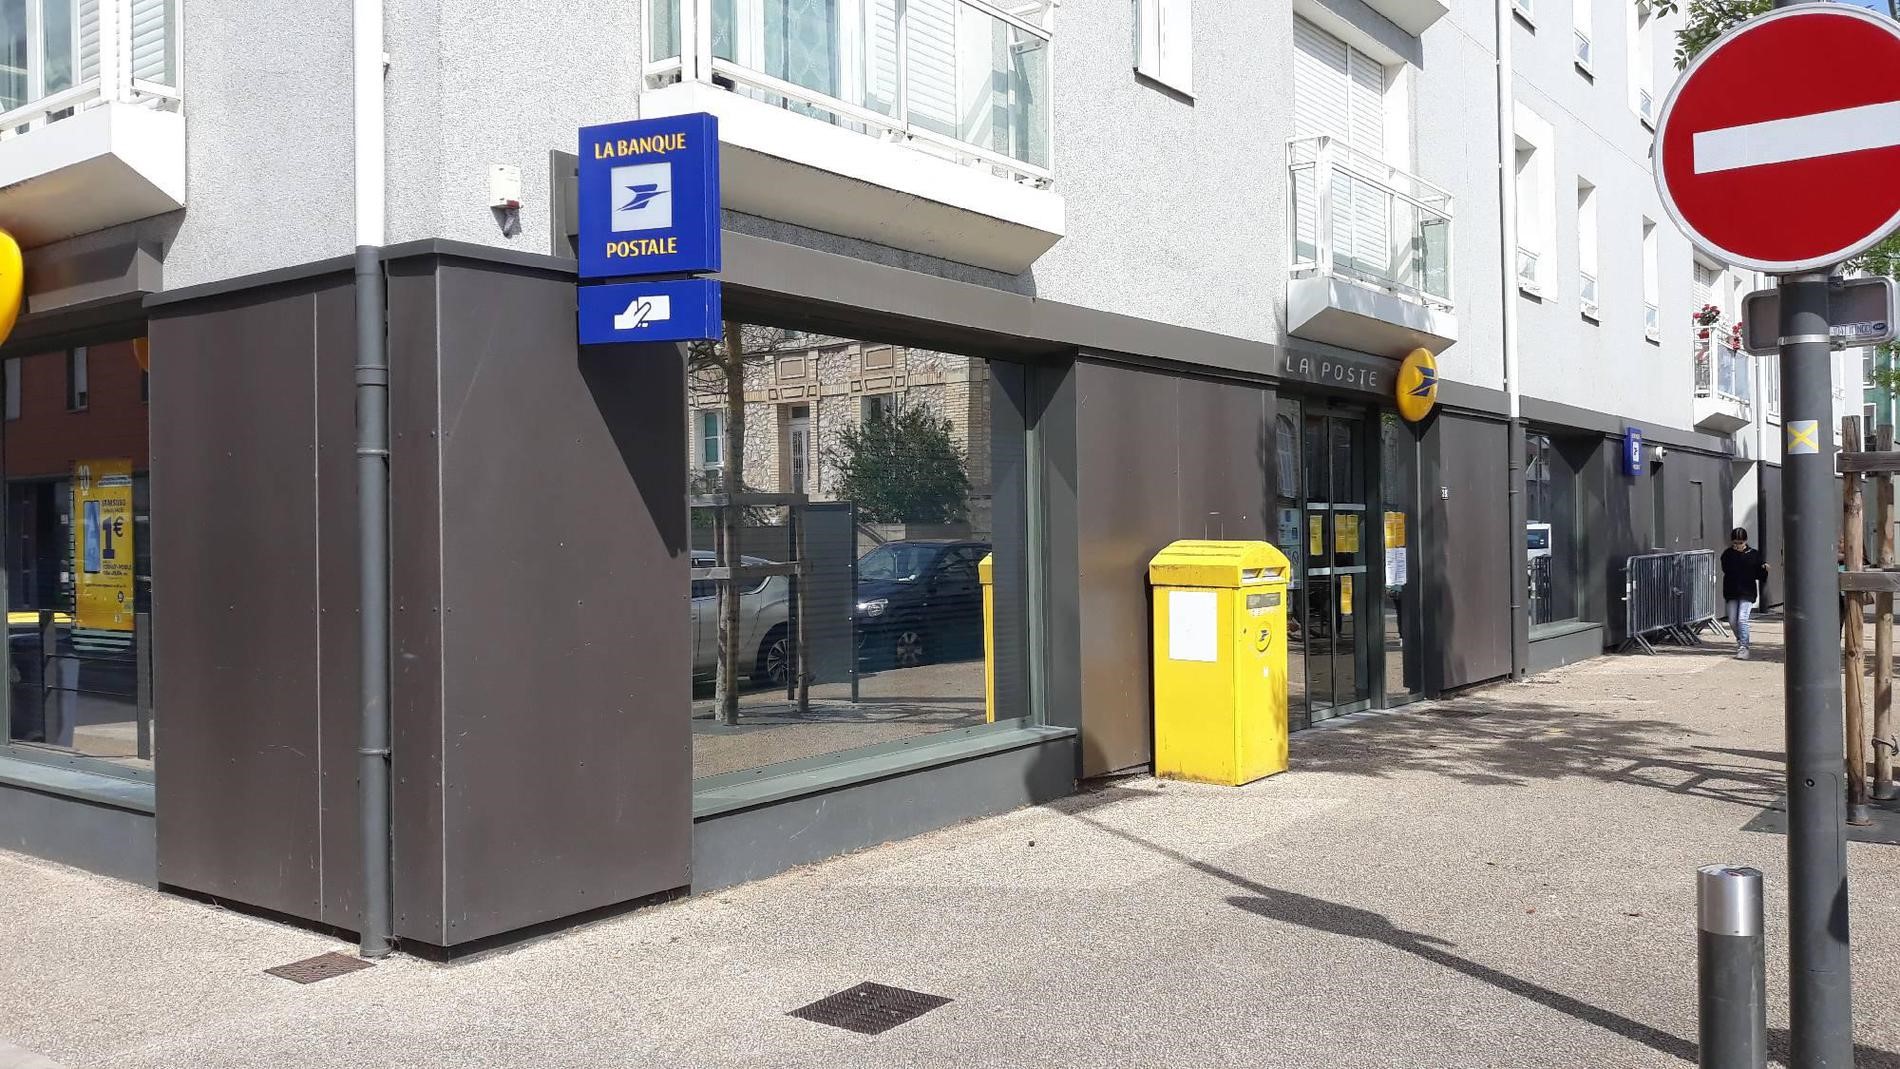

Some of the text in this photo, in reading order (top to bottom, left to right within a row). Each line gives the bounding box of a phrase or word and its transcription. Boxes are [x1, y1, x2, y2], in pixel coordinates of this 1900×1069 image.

[594, 132, 687, 160] LA BANQUE
[606, 236, 678, 259] POSTALE
[1285, 355, 1378, 387] LA POSTE
